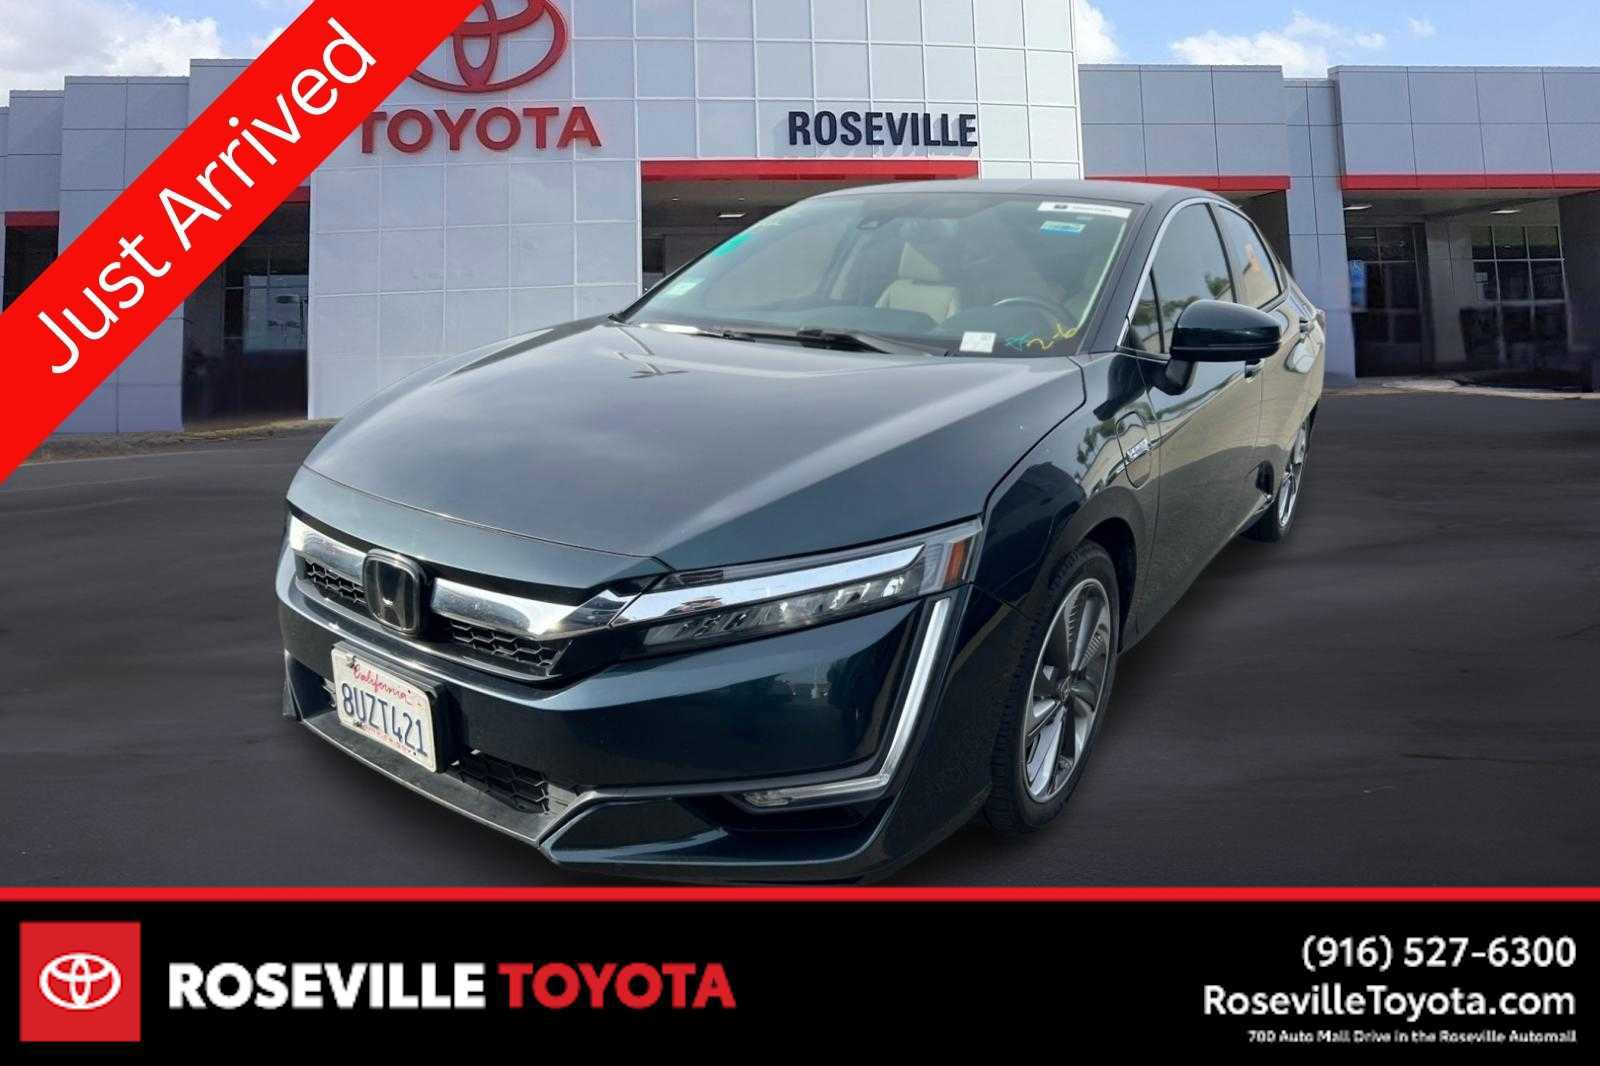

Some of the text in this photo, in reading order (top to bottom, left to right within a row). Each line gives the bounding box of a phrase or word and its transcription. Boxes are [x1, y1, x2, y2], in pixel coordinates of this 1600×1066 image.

[361, 106, 602, 154] TOYOTA
[788, 110, 978, 147] ROSEVILLE
[341, 683, 428, 757] 8UZT421
